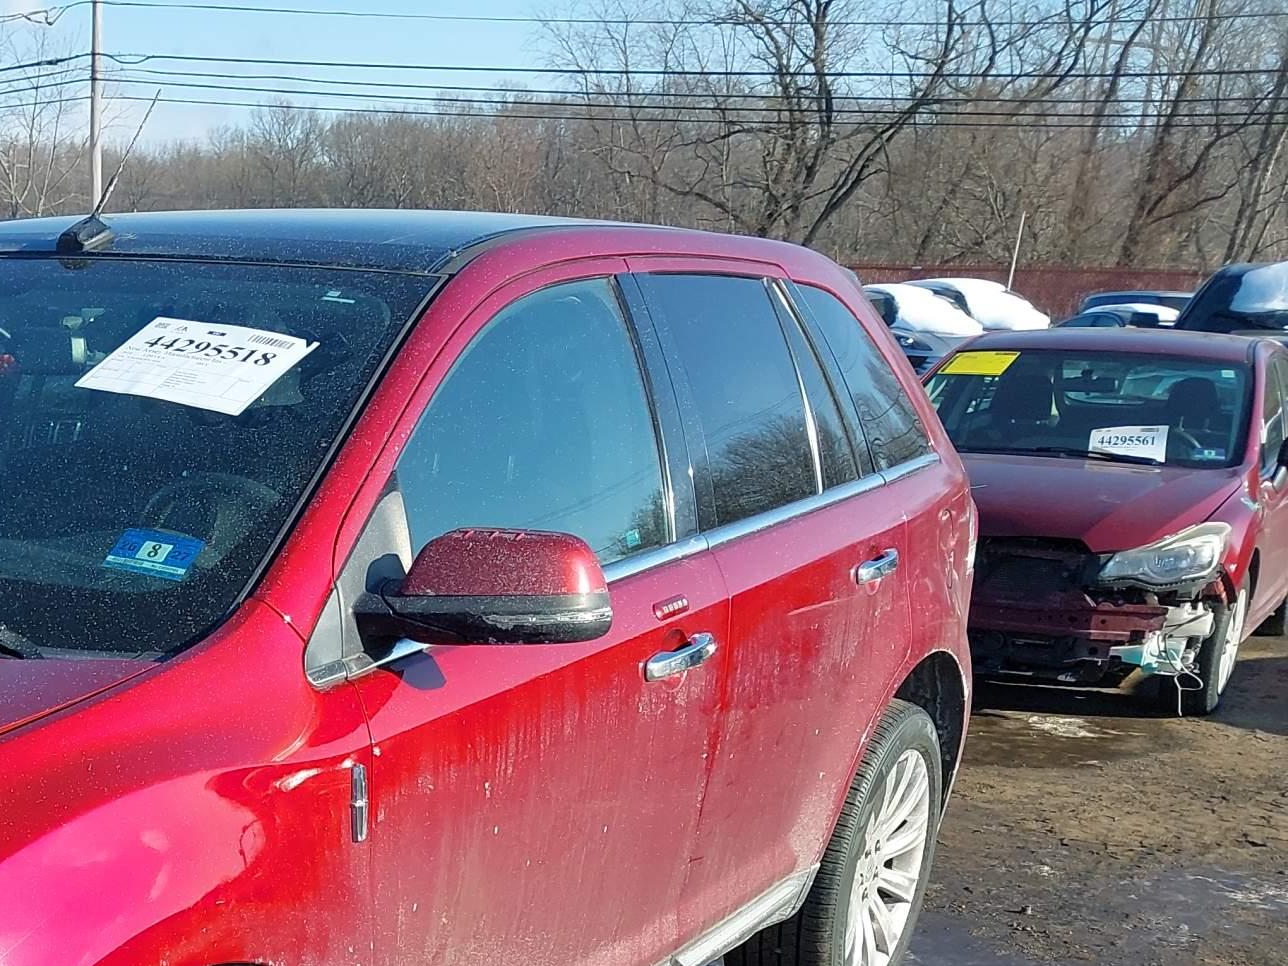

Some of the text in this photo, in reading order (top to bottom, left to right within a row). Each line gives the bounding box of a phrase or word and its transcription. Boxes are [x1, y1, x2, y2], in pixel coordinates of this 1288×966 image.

[144, 335, 277, 366] 44295518
[1098, 435, 1156, 446] 44295561
[147, 543, 162, 558] 8
